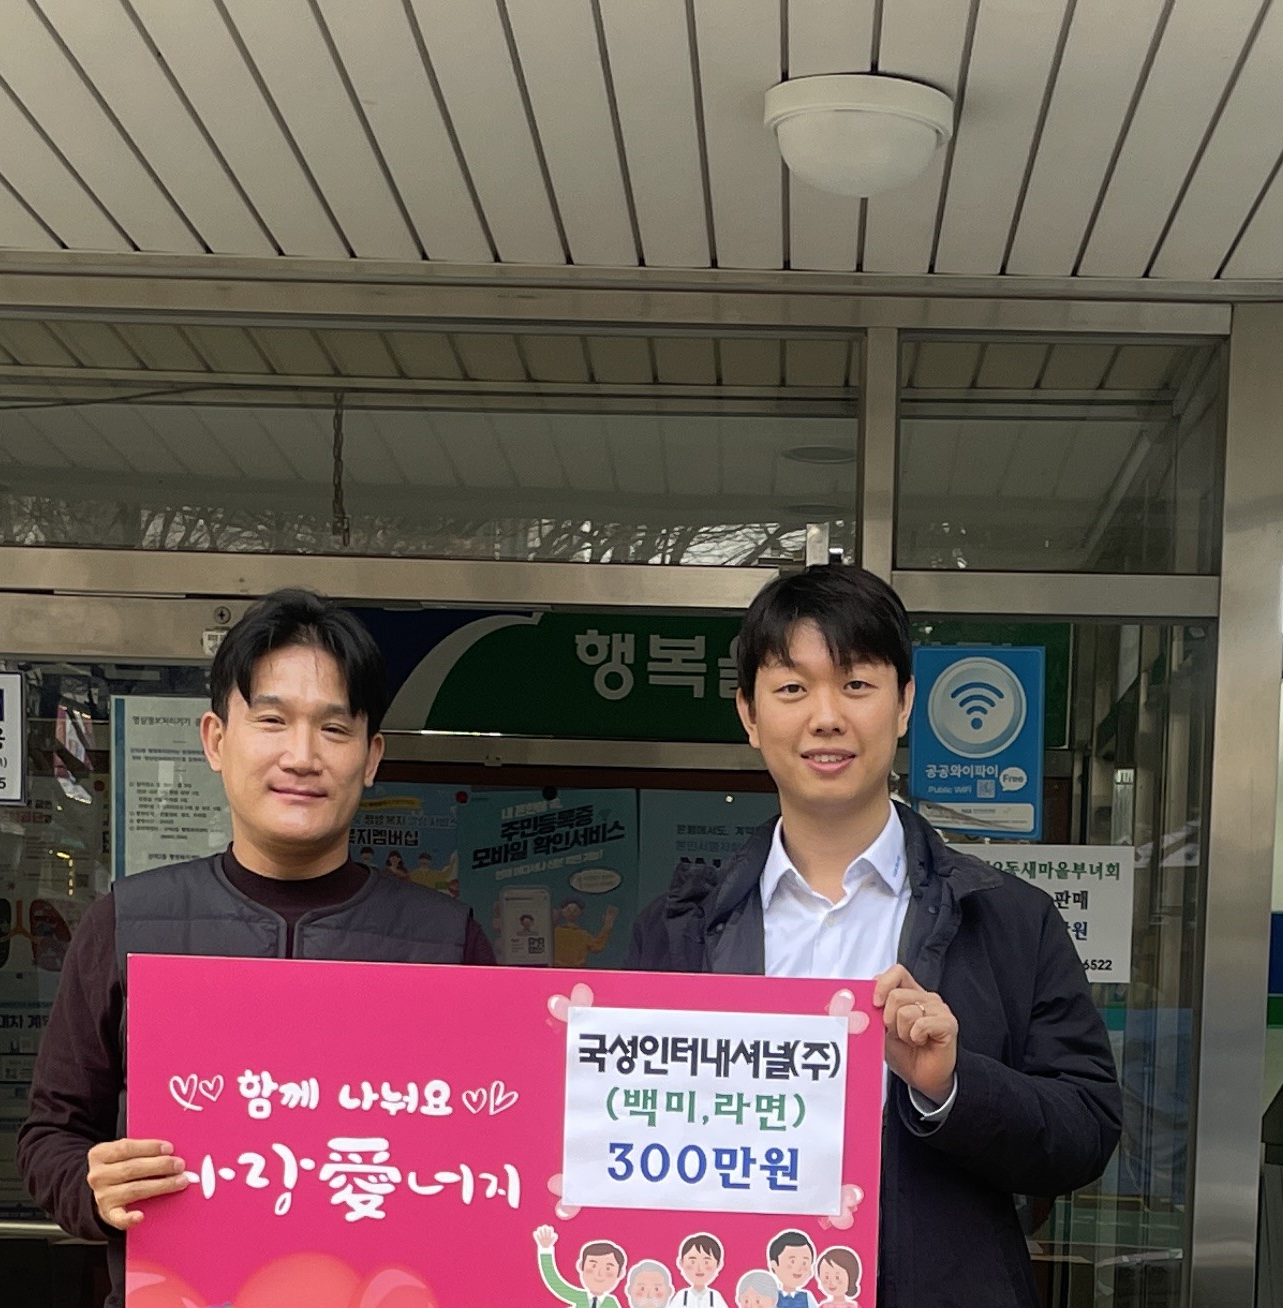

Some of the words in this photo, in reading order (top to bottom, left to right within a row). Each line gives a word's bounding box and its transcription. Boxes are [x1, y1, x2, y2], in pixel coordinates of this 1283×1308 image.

[926, 764, 998, 778] 공공와이파이
[472, 840, 528, 869] 모바일
[533, 820, 625, 856] 확인서비스
[579, 1033, 841, 1081] 국성인터내셔널(주)
[237, 1069, 319, 1119] 함께
[338, 1079, 453, 1116] 나눠요
[606, 1087, 805, 1131] (백미,라면)
[607, 1142, 799, 1191] 300만원
